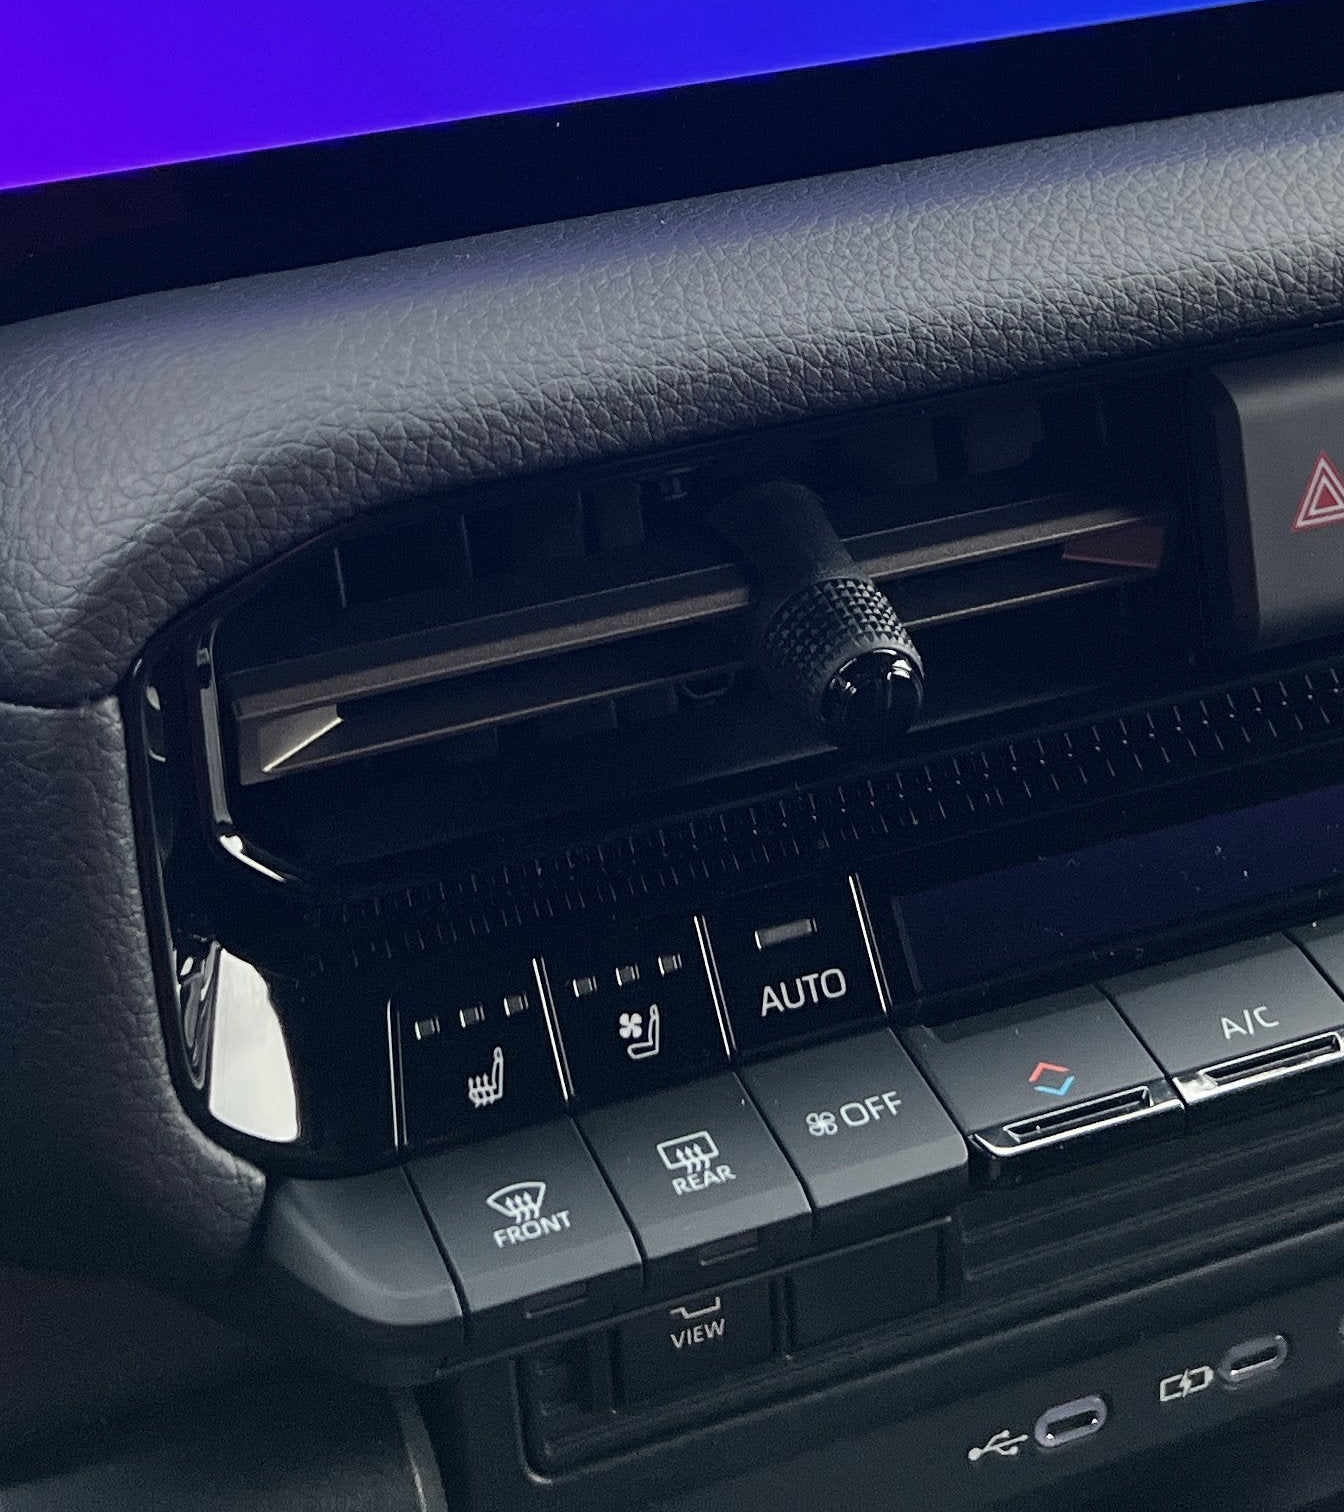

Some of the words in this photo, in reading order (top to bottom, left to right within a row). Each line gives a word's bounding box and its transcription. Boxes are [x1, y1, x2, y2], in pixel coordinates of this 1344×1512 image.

[759, 966, 849, 1019] AUTO
[1219, 1002, 1281, 1041] A/C
[839, 1089, 905, 1131] OFF
[671, 1161, 737, 1197] REAR
[493, 1207, 573, 1249] FRONT
[669, 1316, 728, 1350] VIEW
